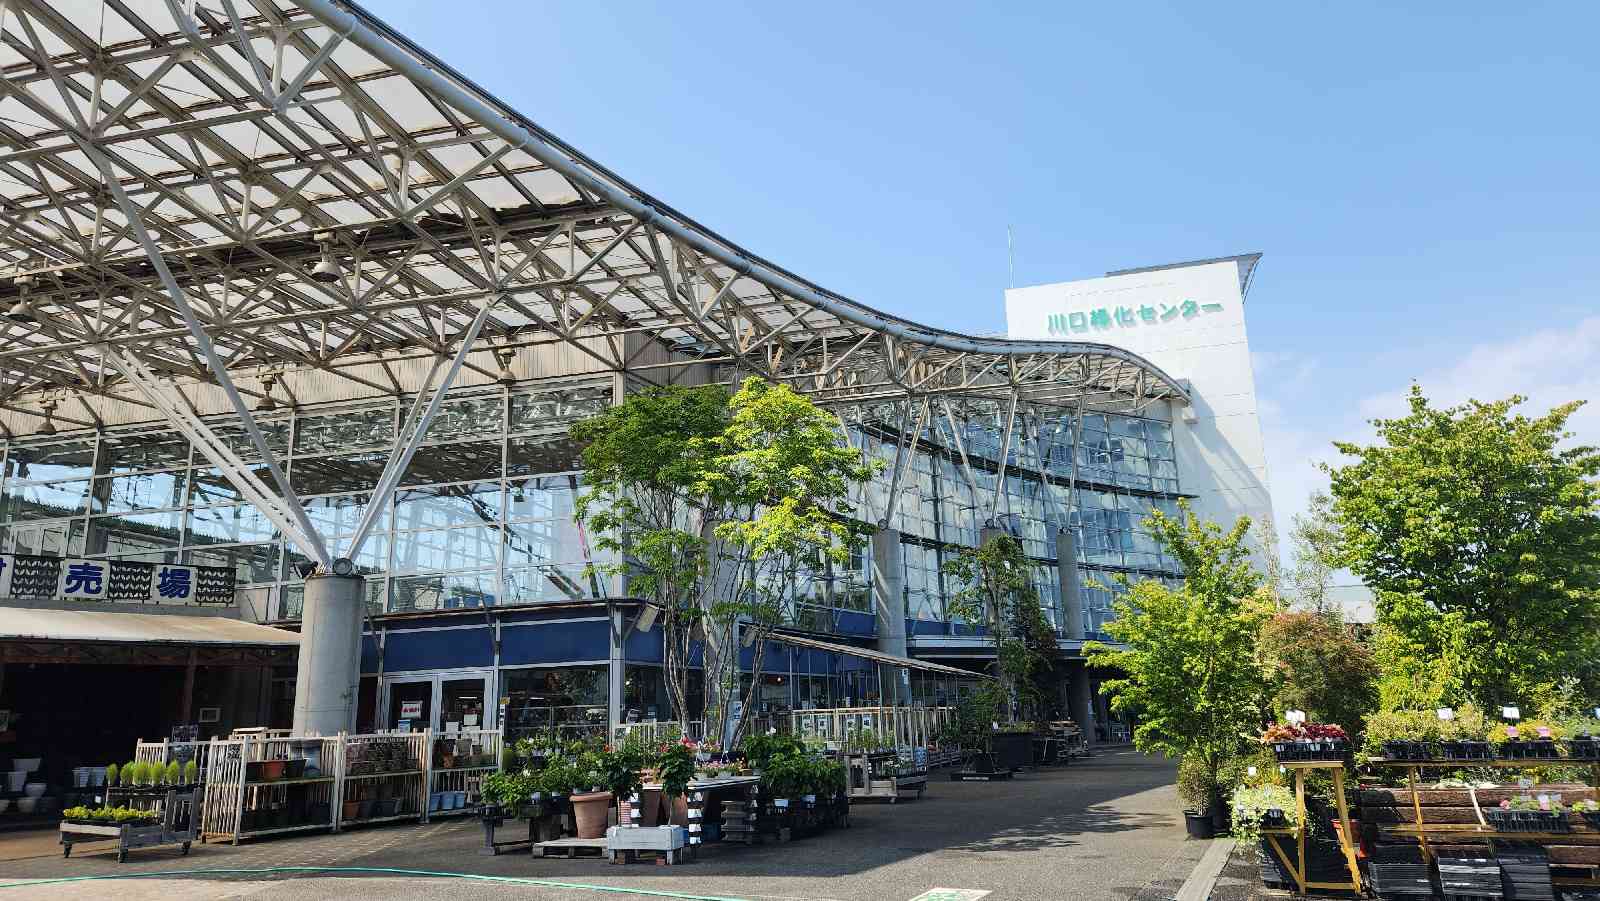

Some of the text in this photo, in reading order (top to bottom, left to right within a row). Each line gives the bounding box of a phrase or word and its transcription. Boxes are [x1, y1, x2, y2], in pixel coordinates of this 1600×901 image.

[1047, 299, 1223, 336] 川口緑化センター
[0, 557, 192, 599] 売場
